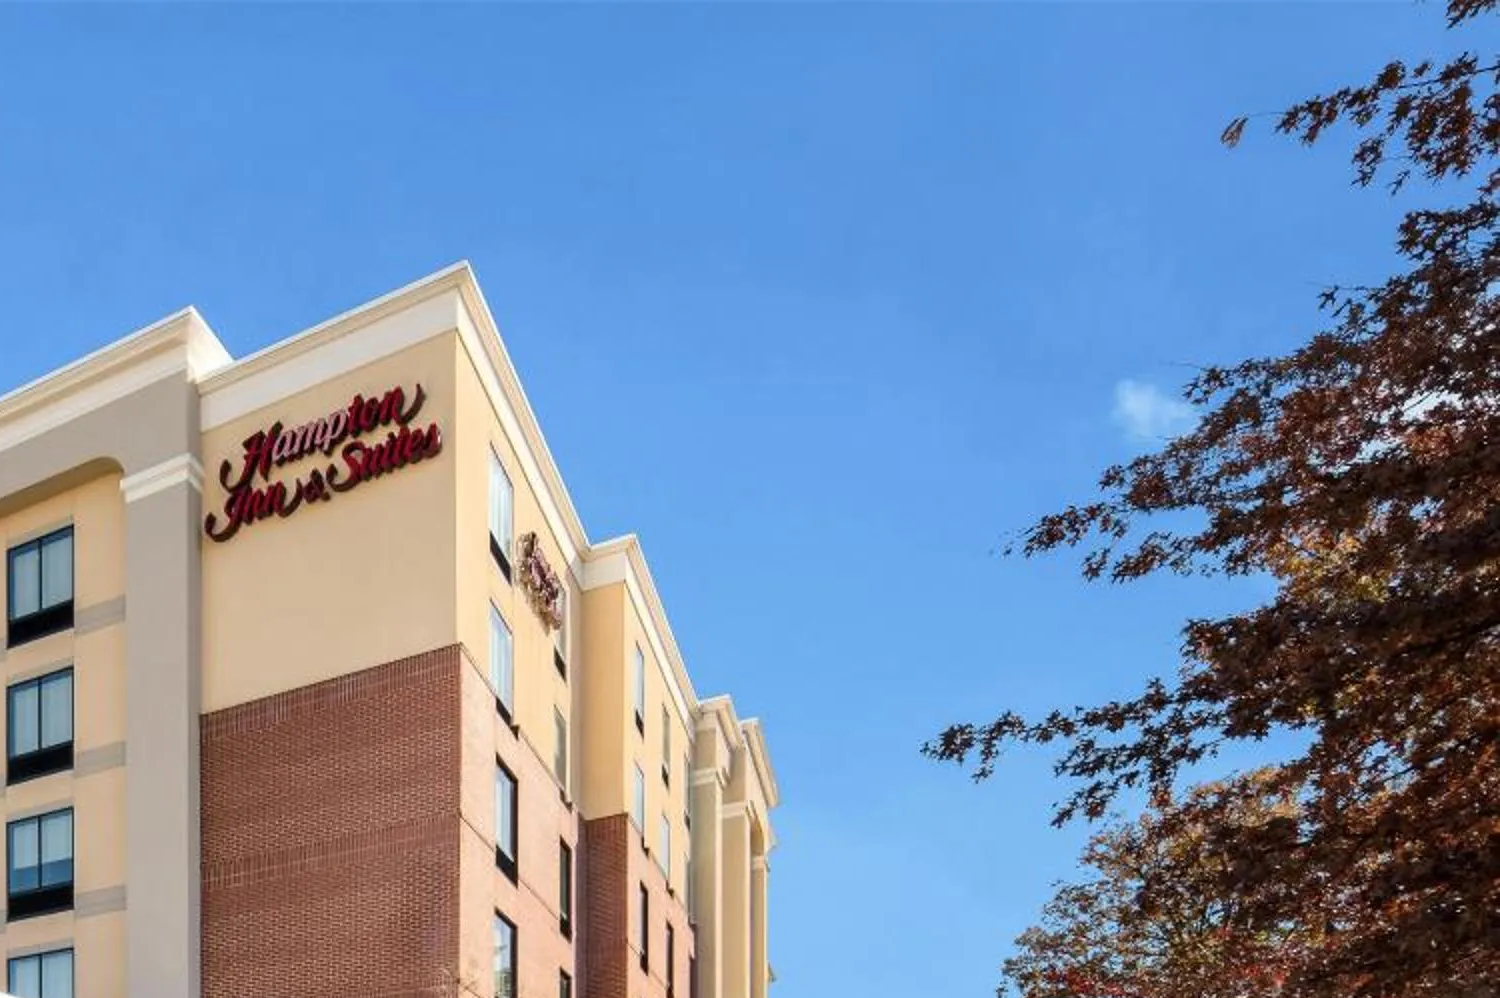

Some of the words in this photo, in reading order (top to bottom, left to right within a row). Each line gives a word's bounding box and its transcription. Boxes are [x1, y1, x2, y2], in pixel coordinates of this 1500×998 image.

[204, 478, 302, 543] Inn
[303, 468, 331, 503] &
[326, 422, 442, 493] Suites
[219, 383, 426, 494] Hampton
